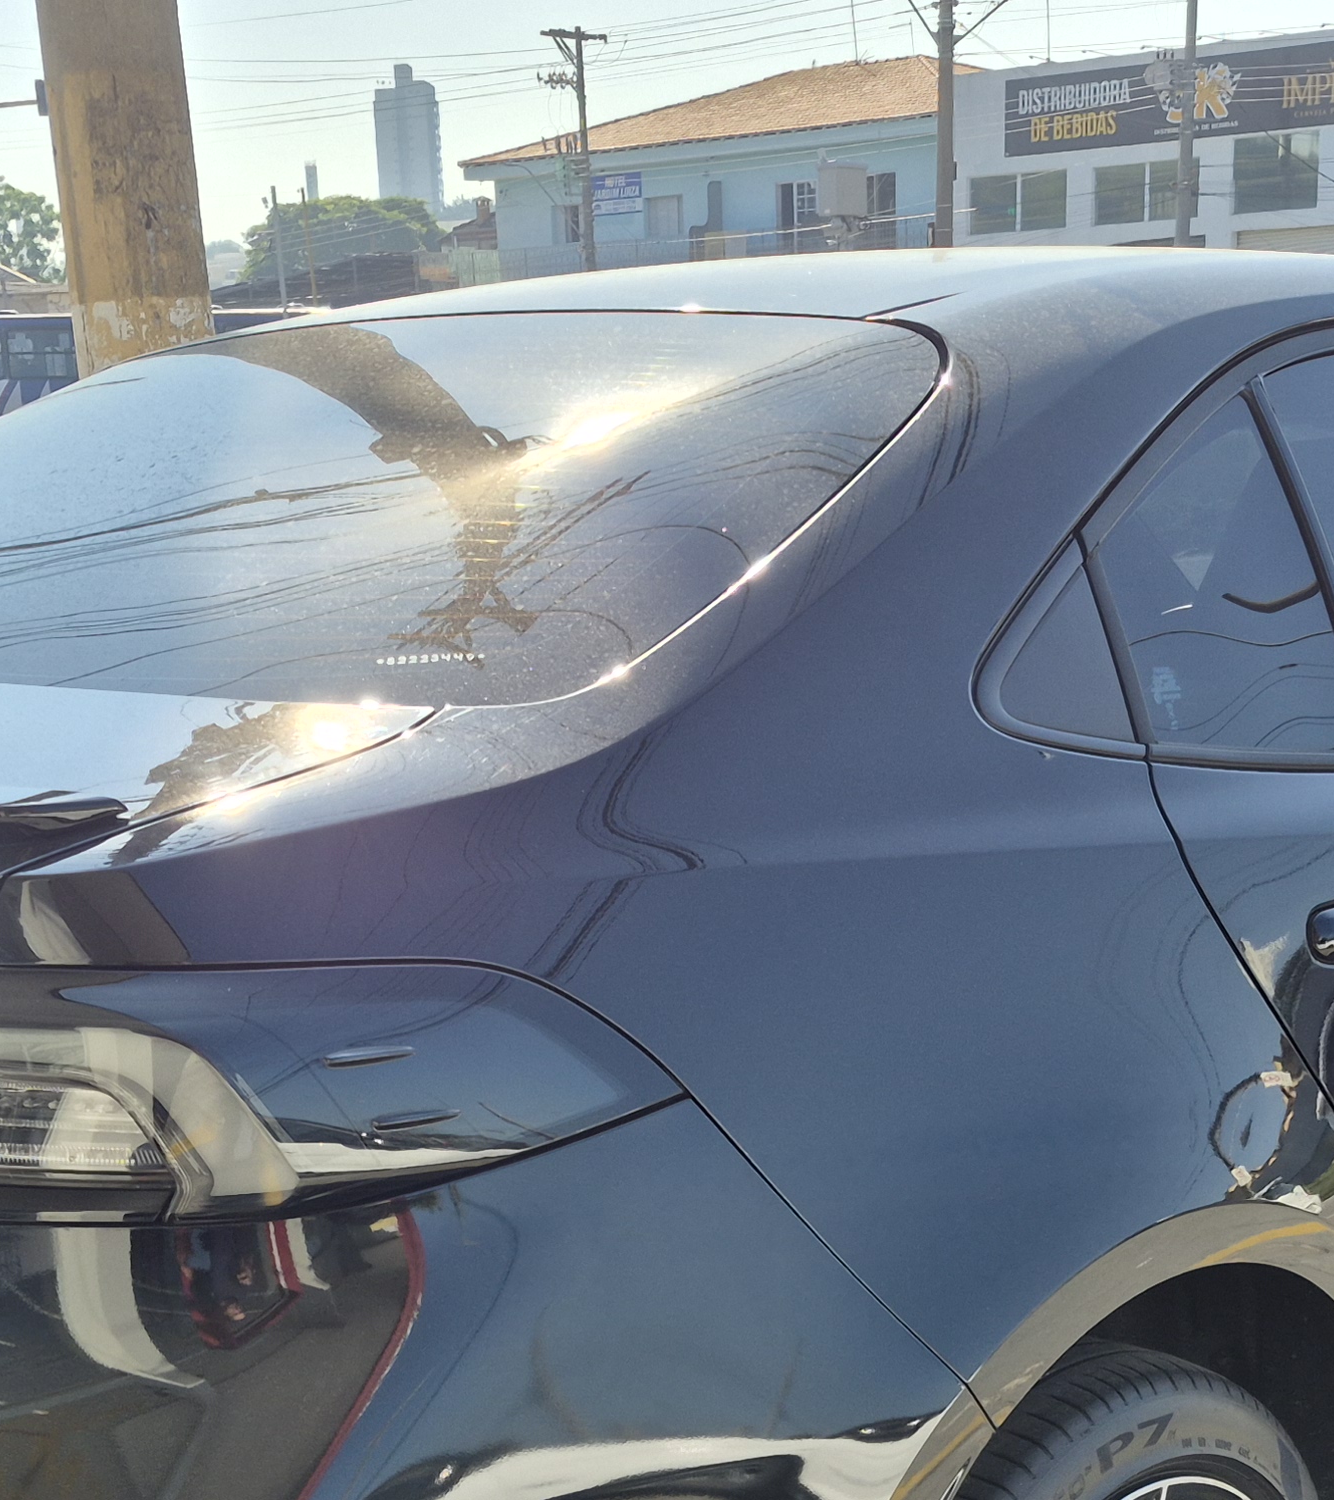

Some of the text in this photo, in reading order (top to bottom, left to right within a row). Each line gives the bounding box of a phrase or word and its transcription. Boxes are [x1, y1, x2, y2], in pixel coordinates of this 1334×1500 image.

[1018, 78, 1130, 115] DISTRIBUIDORA
[1030, 110, 1117, 143] DE BEBIDAS
[1096, 1412, 1174, 1475] P7
